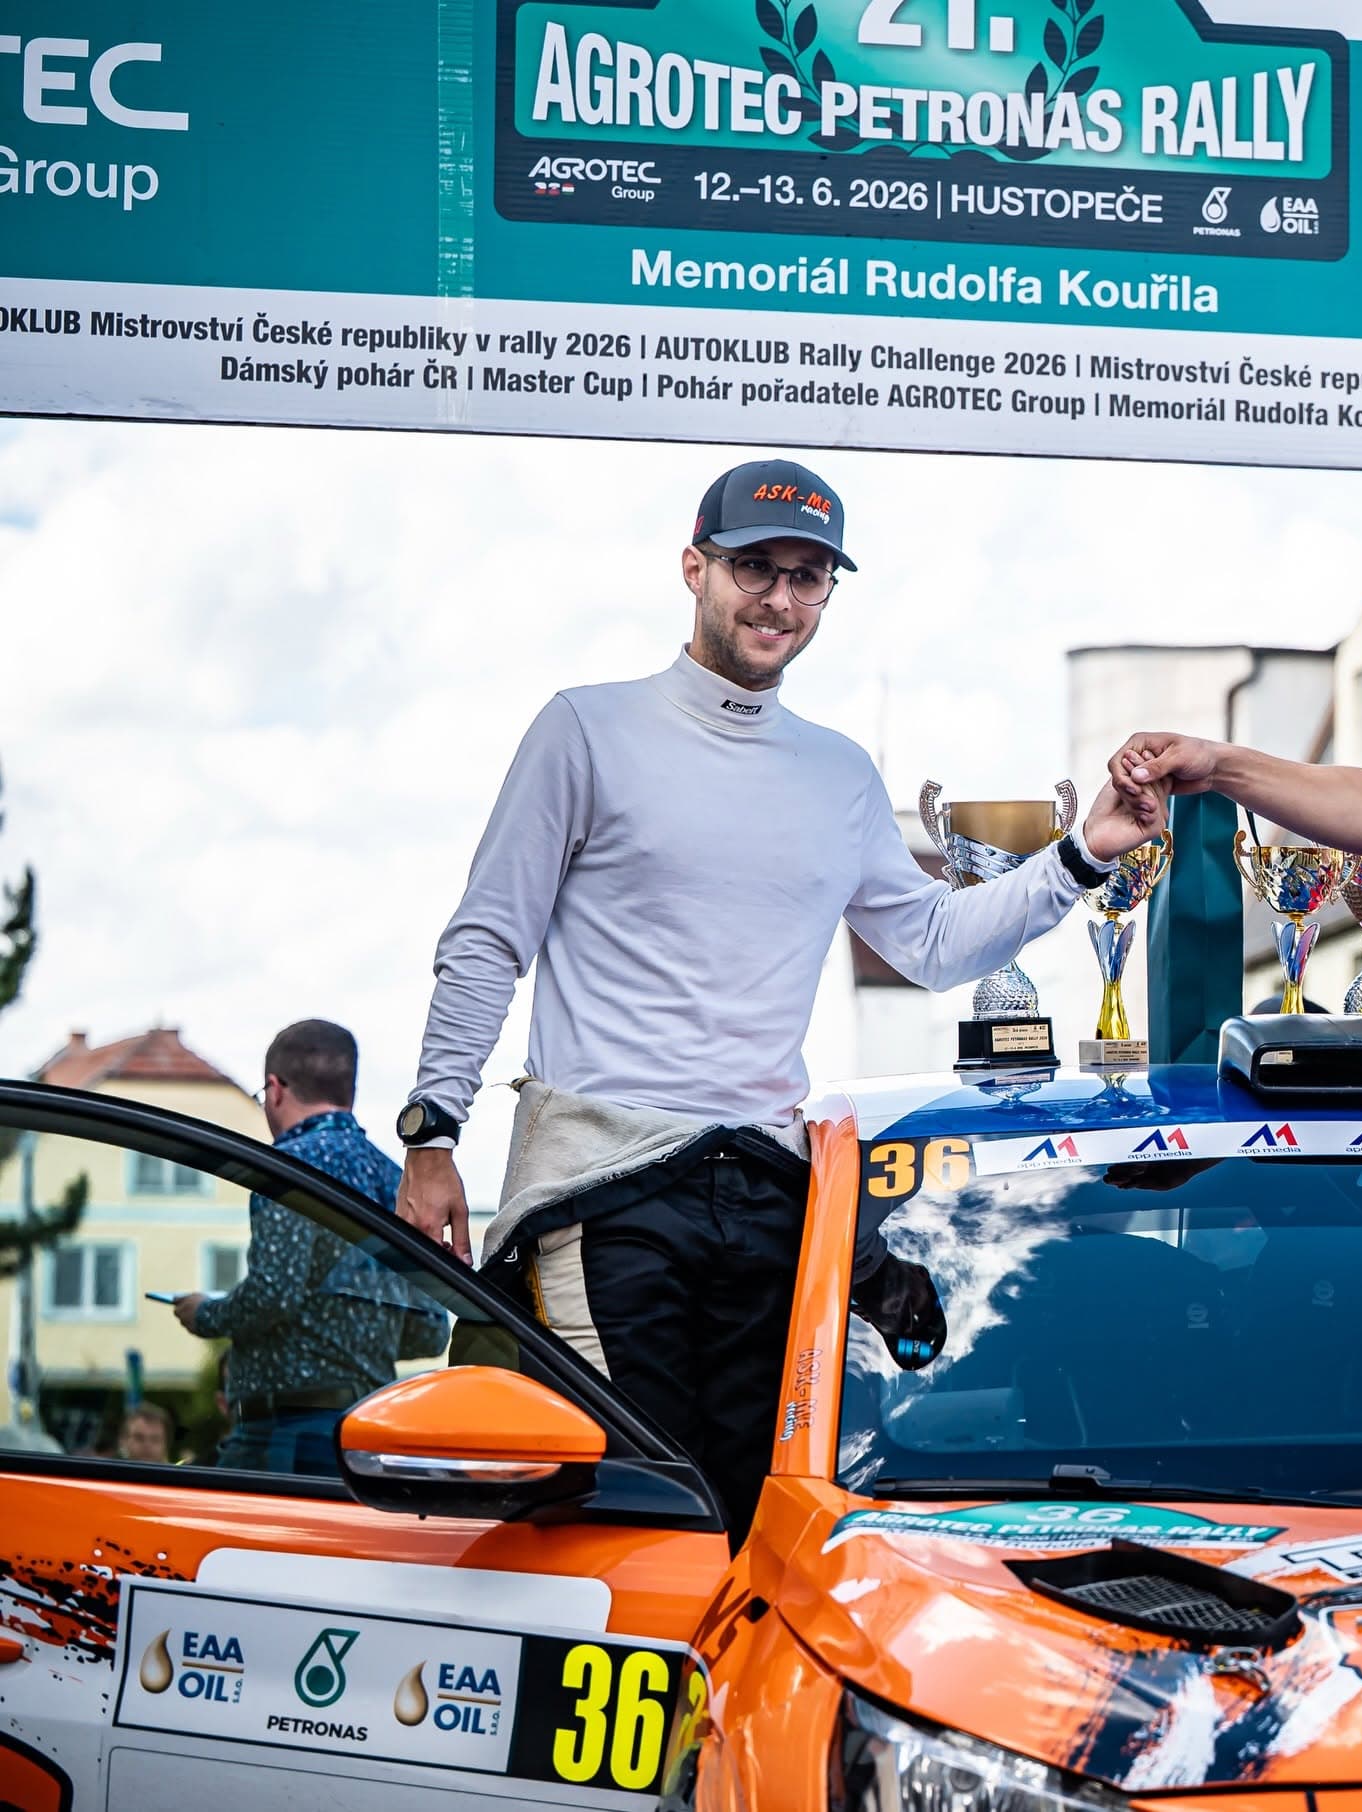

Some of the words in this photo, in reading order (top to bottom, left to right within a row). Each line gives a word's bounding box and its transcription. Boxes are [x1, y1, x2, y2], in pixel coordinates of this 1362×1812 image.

[532, 21, 802, 136] AGROTEC
[820, 81, 1123, 153] PETRONAS
[1142, 62, 1315, 162] RALLY
[528, 156, 662, 184] AGROTEC
[611, 186, 655, 202] Group
[812, 177, 841, 208] 6.
[850, 180, 928, 212] 2026
[951, 184, 1163, 224] HUSTOPEČE
[1283, 197, 1318, 214] EAA
[1193, 226, 1241, 238] PETRONAS
[1282, 217, 1313, 235] OIL
[631, 248, 849, 296] Memoriál
[866, 258, 1042, 305] Rudolfa
[1059, 269, 1219, 314] Kouřila
[90, 311, 243, 343] Mistrovství
[252, 313, 333, 346] České
[341, 324, 467, 357] republiky
[475, 333, 490, 351] v
[499, 330, 558, 360] rally
[566, 333, 631, 359] 2026
[654, 335, 790, 365] AUTOKLUB
[799, 342, 863, 373] Rally
[870, 345, 995, 379] Challenge
[1003, 352, 1066, 378] 2026
[1090, 355, 1230, 386] Mistrovství
[1239, 357, 1312, 389] České
[221, 356, 328, 389] Dámský
[337, 360, 415, 392] pohár
[423, 360, 457, 390] ČR
[482, 367, 574, 396] Master
[584, 371, 633, 401] Cup
[657, 373, 733, 401] Pohár
[741, 379, 879, 408] pořadatele
[888, 384, 1002, 412] AGROTEC
[1011, 389, 1086, 419] Group
[1109, 395, 1226, 421] Memoriál
[1235, 400, 1328, 428] Rudolfa
[1128, 1150, 1155, 1160] app
[1157, 1149, 1193, 1158] media
[1237, 1147, 1263, 1155] app
[1265, 1145, 1301, 1153] media
[867, 1138, 970, 1199] 36
[853, 1511, 993, 1532] AGROTEC
[997, 1523, 1163, 1535] PETRONAS
[1167, 1526, 1268, 1537] RALLY
[1025, 1504, 1134, 1525] 36
[182, 1632, 244, 1664] EAA
[178, 1670, 230, 1703] OIL
[437, 1664, 500, 1696] EAA
[266, 1715, 368, 1742] PETRONAS
[433, 1702, 486, 1735] OIL
[552, 1644, 670, 1790] 36
